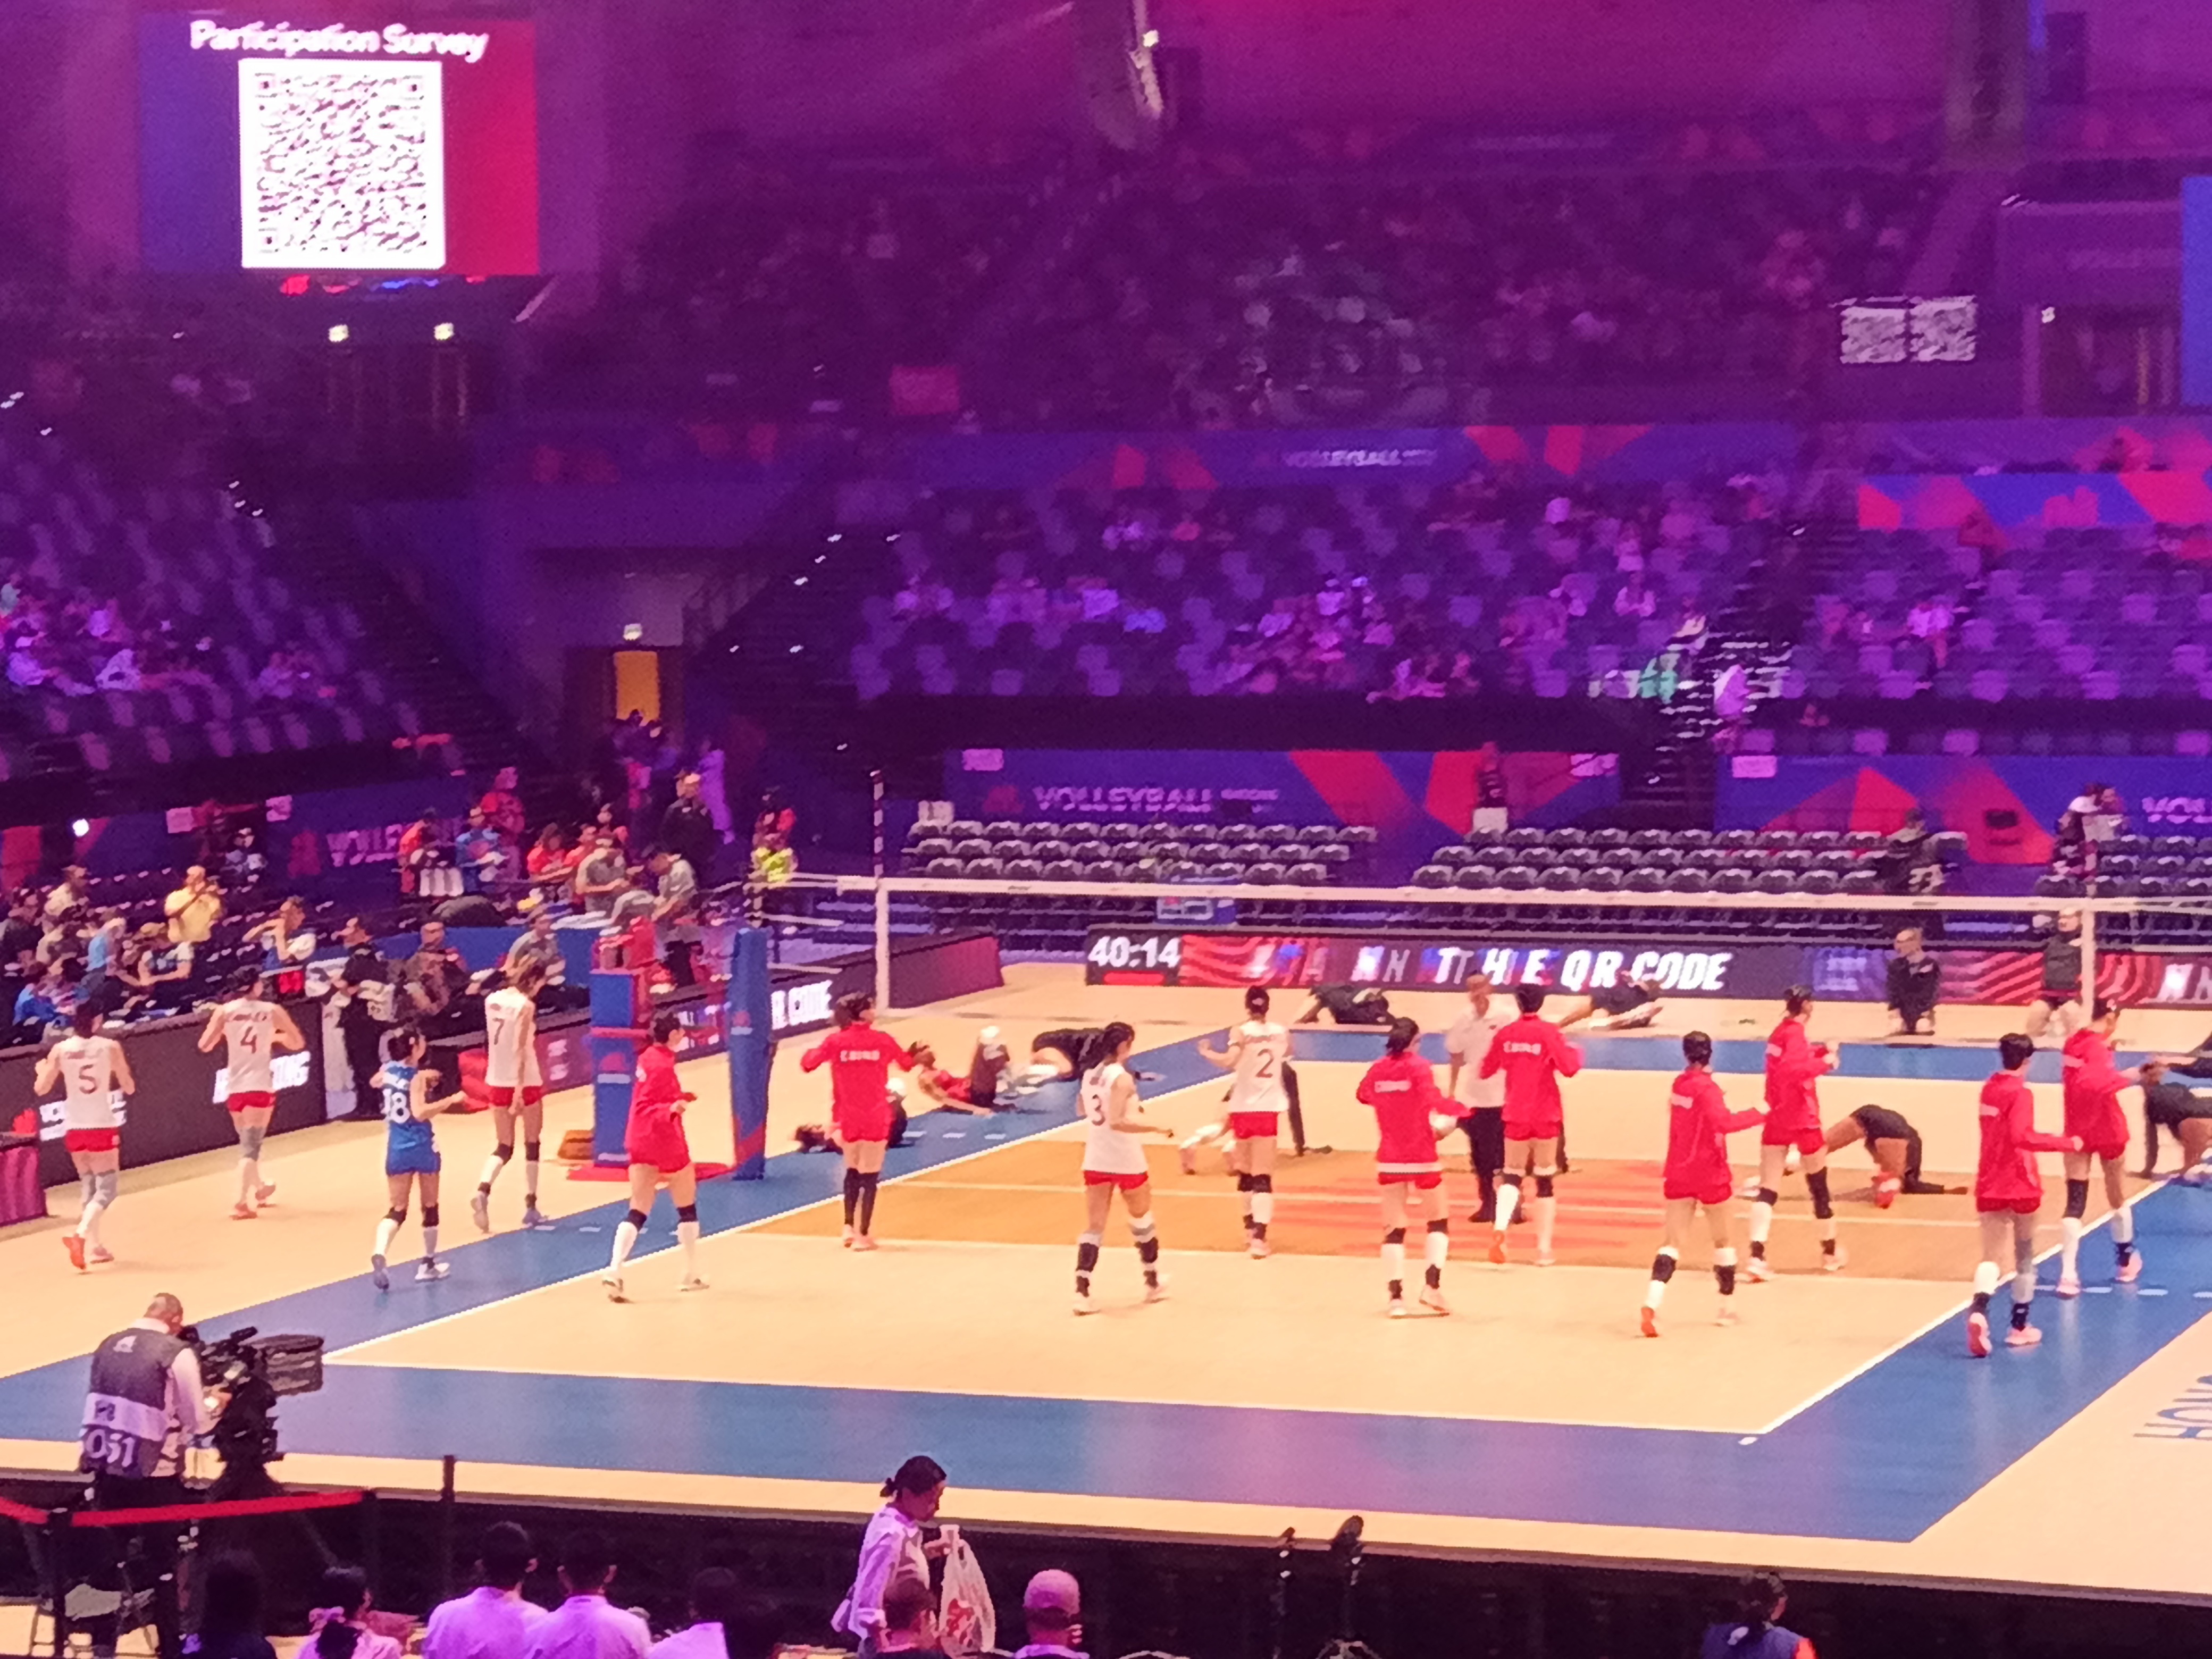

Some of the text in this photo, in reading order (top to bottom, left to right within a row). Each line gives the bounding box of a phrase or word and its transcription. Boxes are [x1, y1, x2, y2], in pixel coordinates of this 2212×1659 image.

[190, 20, 489, 63] Participation Survey
[1088, 936, 1181, 968] 40:14
[1561, 950, 1623, 992] QR
[1630, 951, 1733, 990] CODE
[241, 1026, 257, 1054] 4
[492, 1018, 505, 1045] 7
[1255, 1048, 1274, 1078] 2
[79, 1064, 98, 1094] 5
[1091, 1094, 1106, 1126] 3
